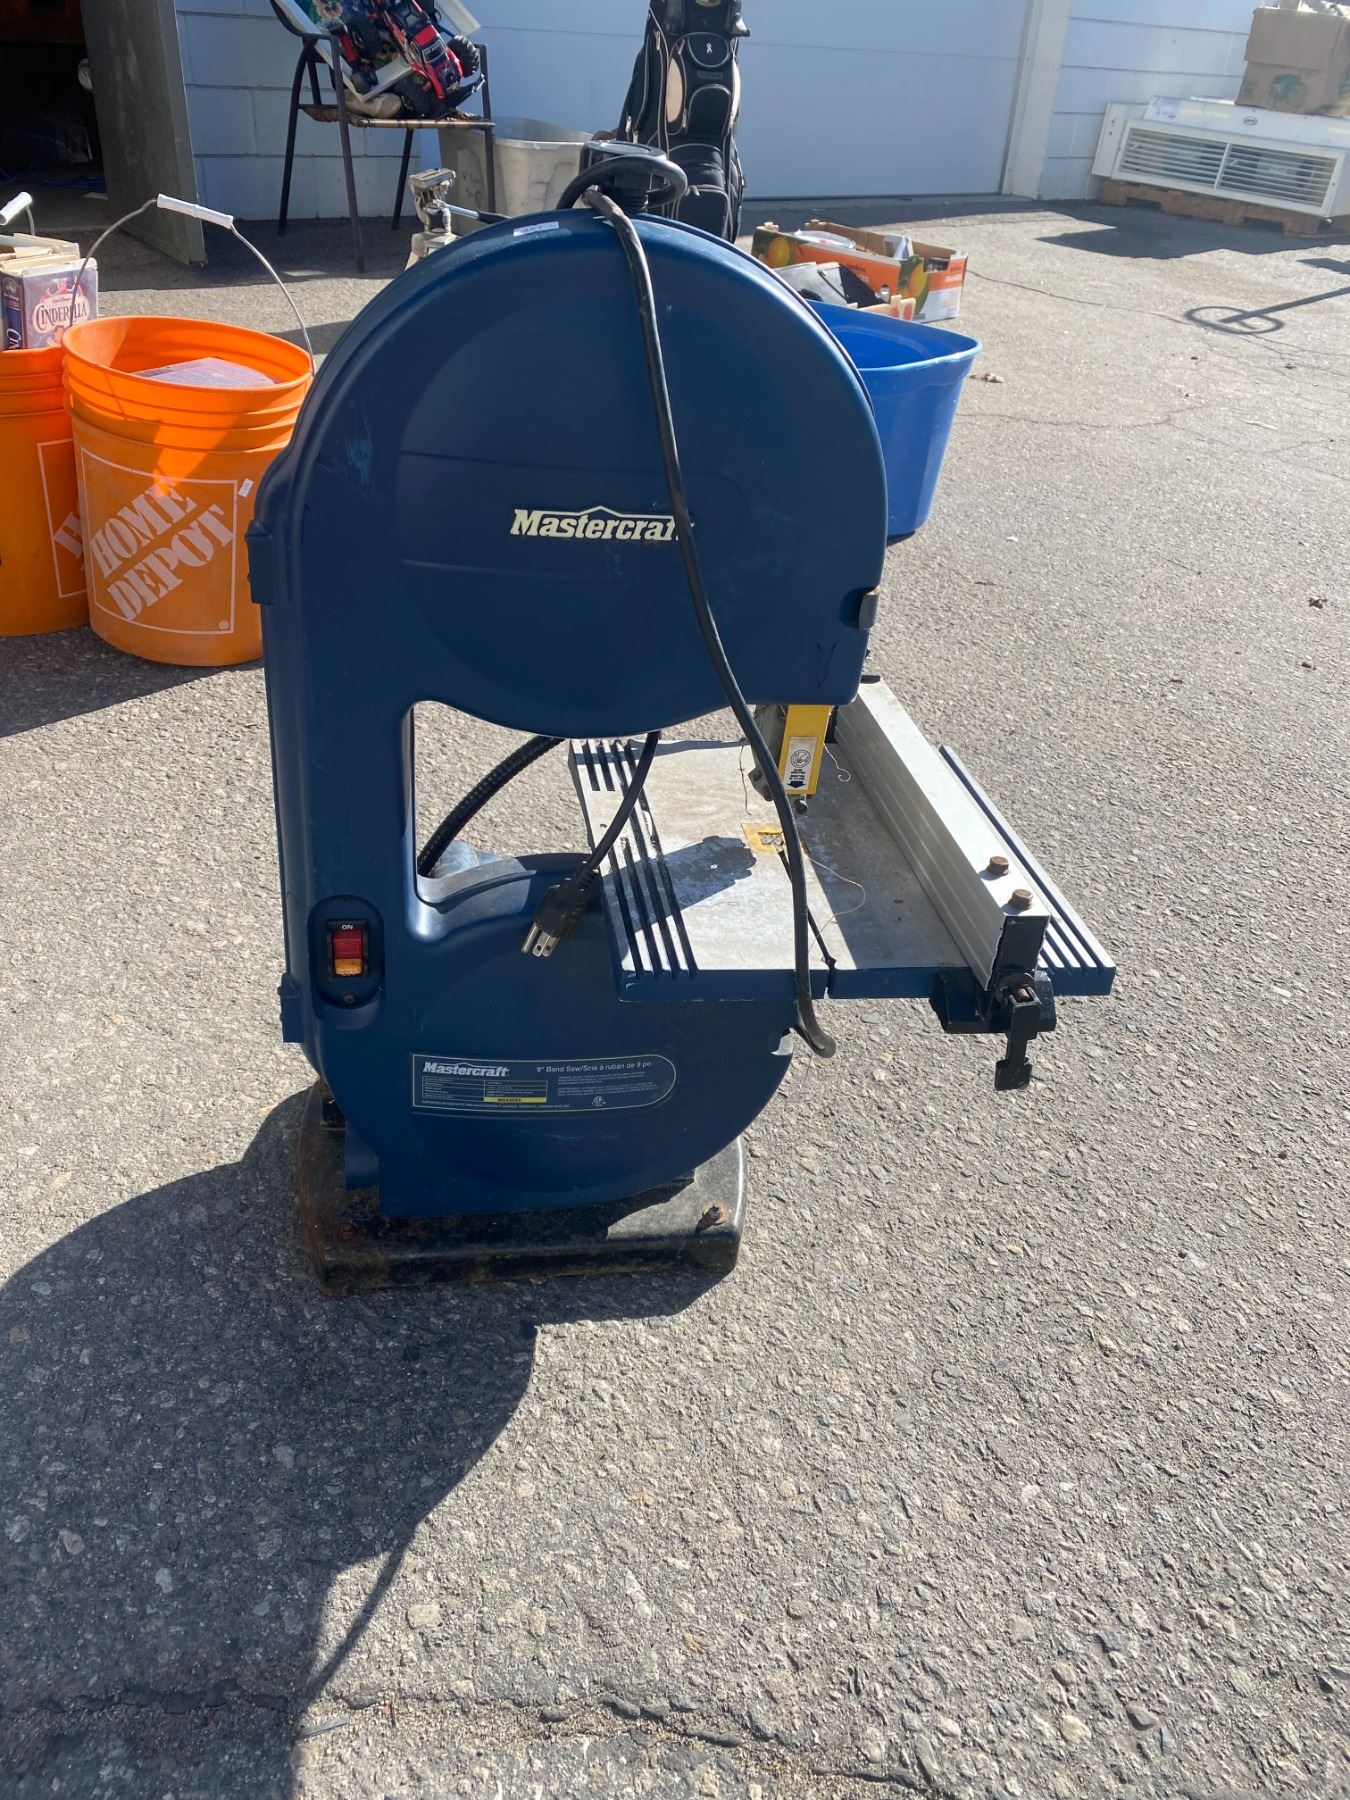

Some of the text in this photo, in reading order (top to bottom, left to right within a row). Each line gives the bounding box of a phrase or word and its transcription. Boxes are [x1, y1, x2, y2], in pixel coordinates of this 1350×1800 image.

[36, 302, 88, 331] CINDERLLA
[89, 477, 198, 579] HOME
[510, 507, 694, 541] Mastercraf
[106, 504, 234, 621] DEPOT
[422, 1061, 509, 1077] Mastercraft
